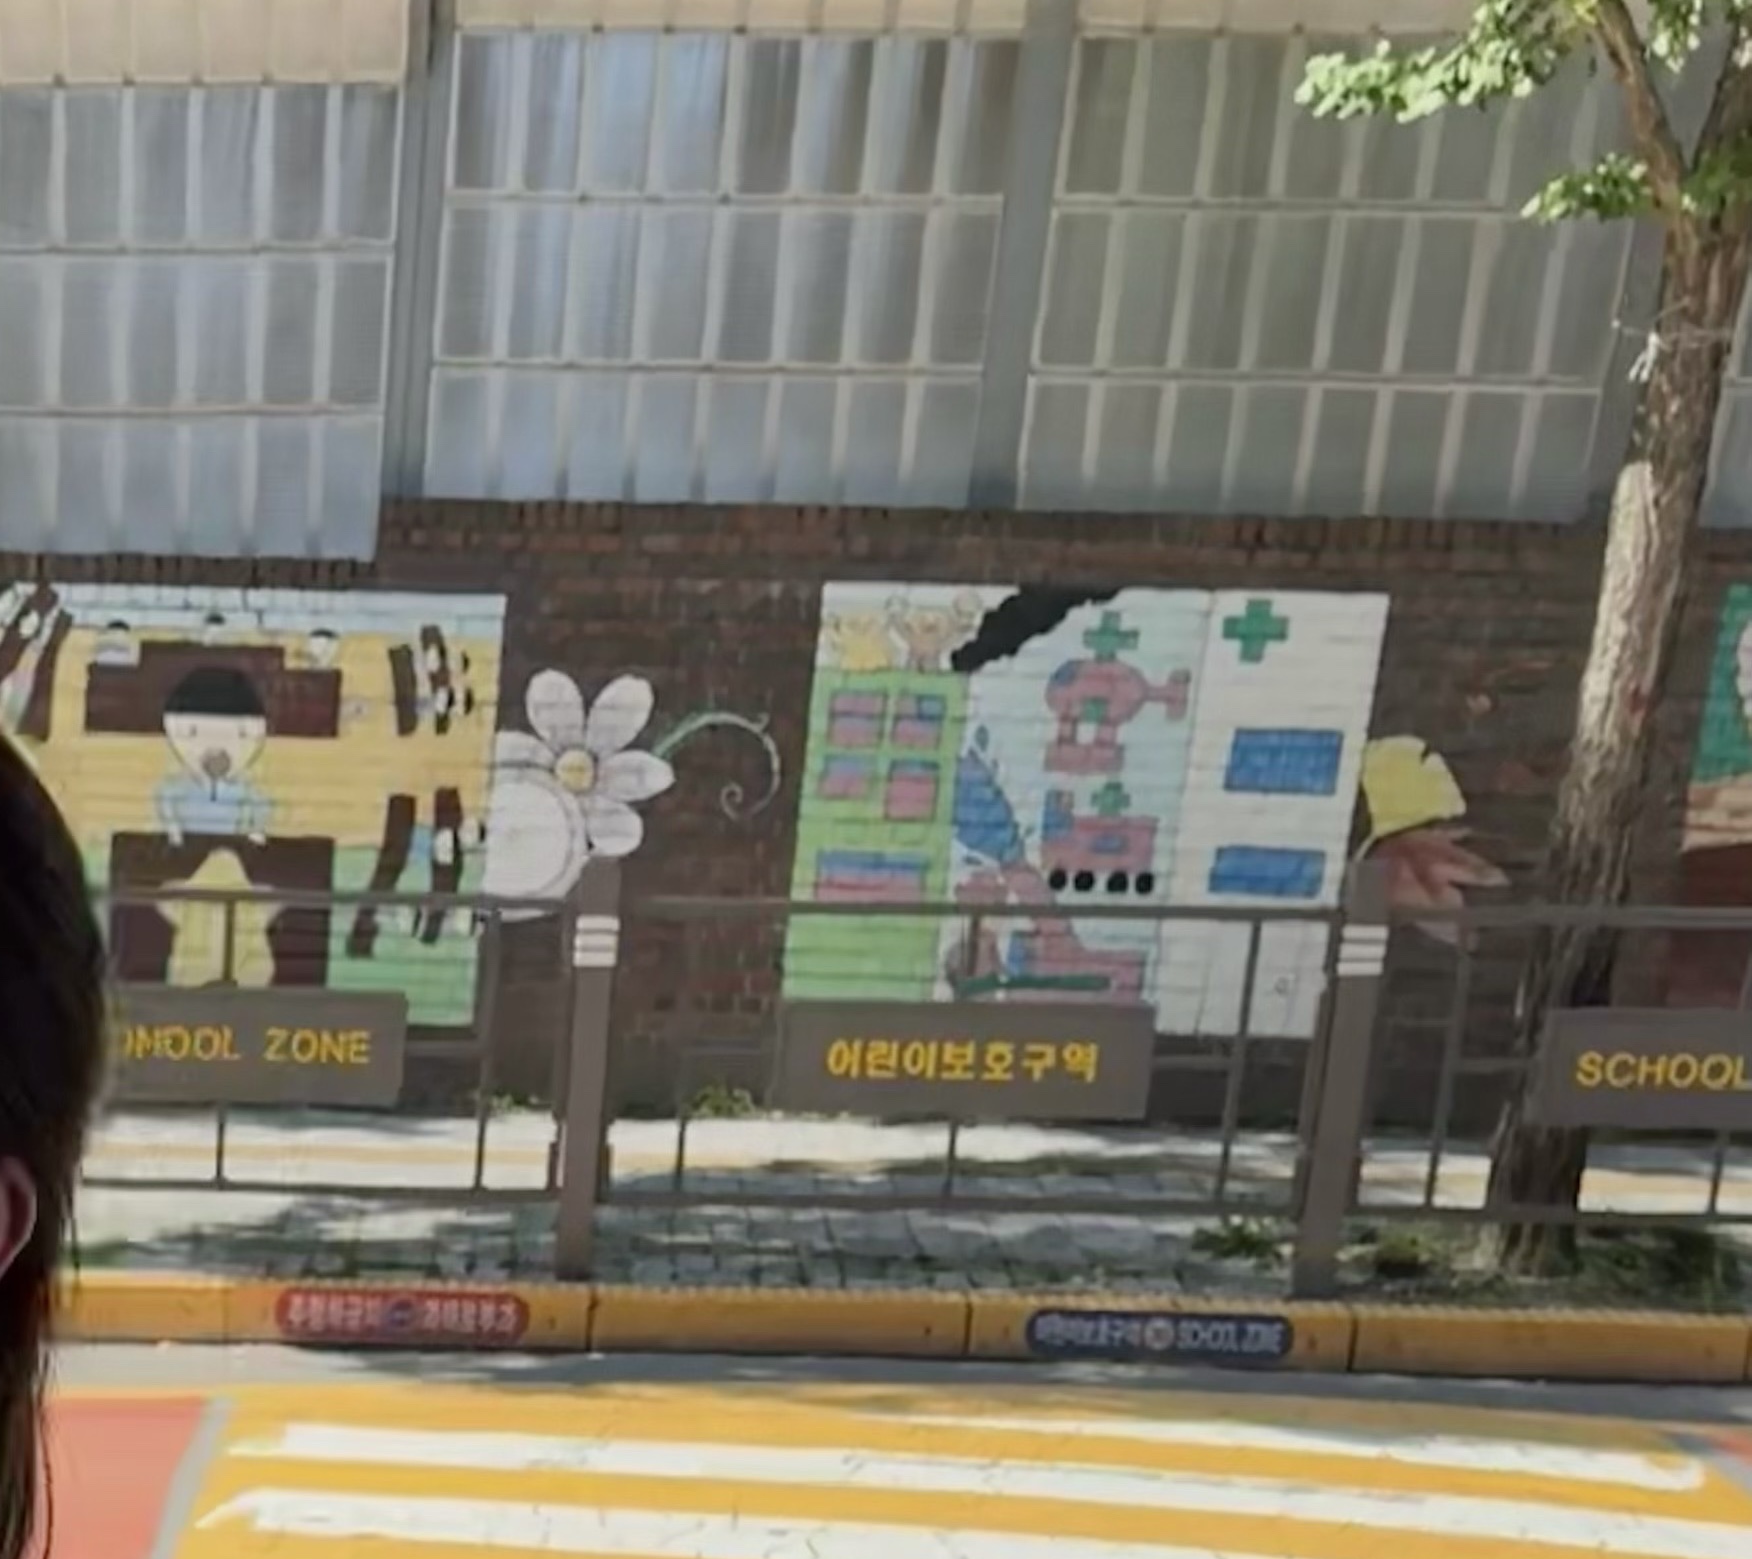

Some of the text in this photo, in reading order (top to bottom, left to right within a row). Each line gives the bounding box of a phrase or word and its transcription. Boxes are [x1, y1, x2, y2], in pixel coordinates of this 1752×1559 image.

[263, 1026, 371, 1065] ZONE
[826, 1038, 1099, 1084] 어린이보호구역
[1575, 1050, 1752, 1091] SCHOOL
